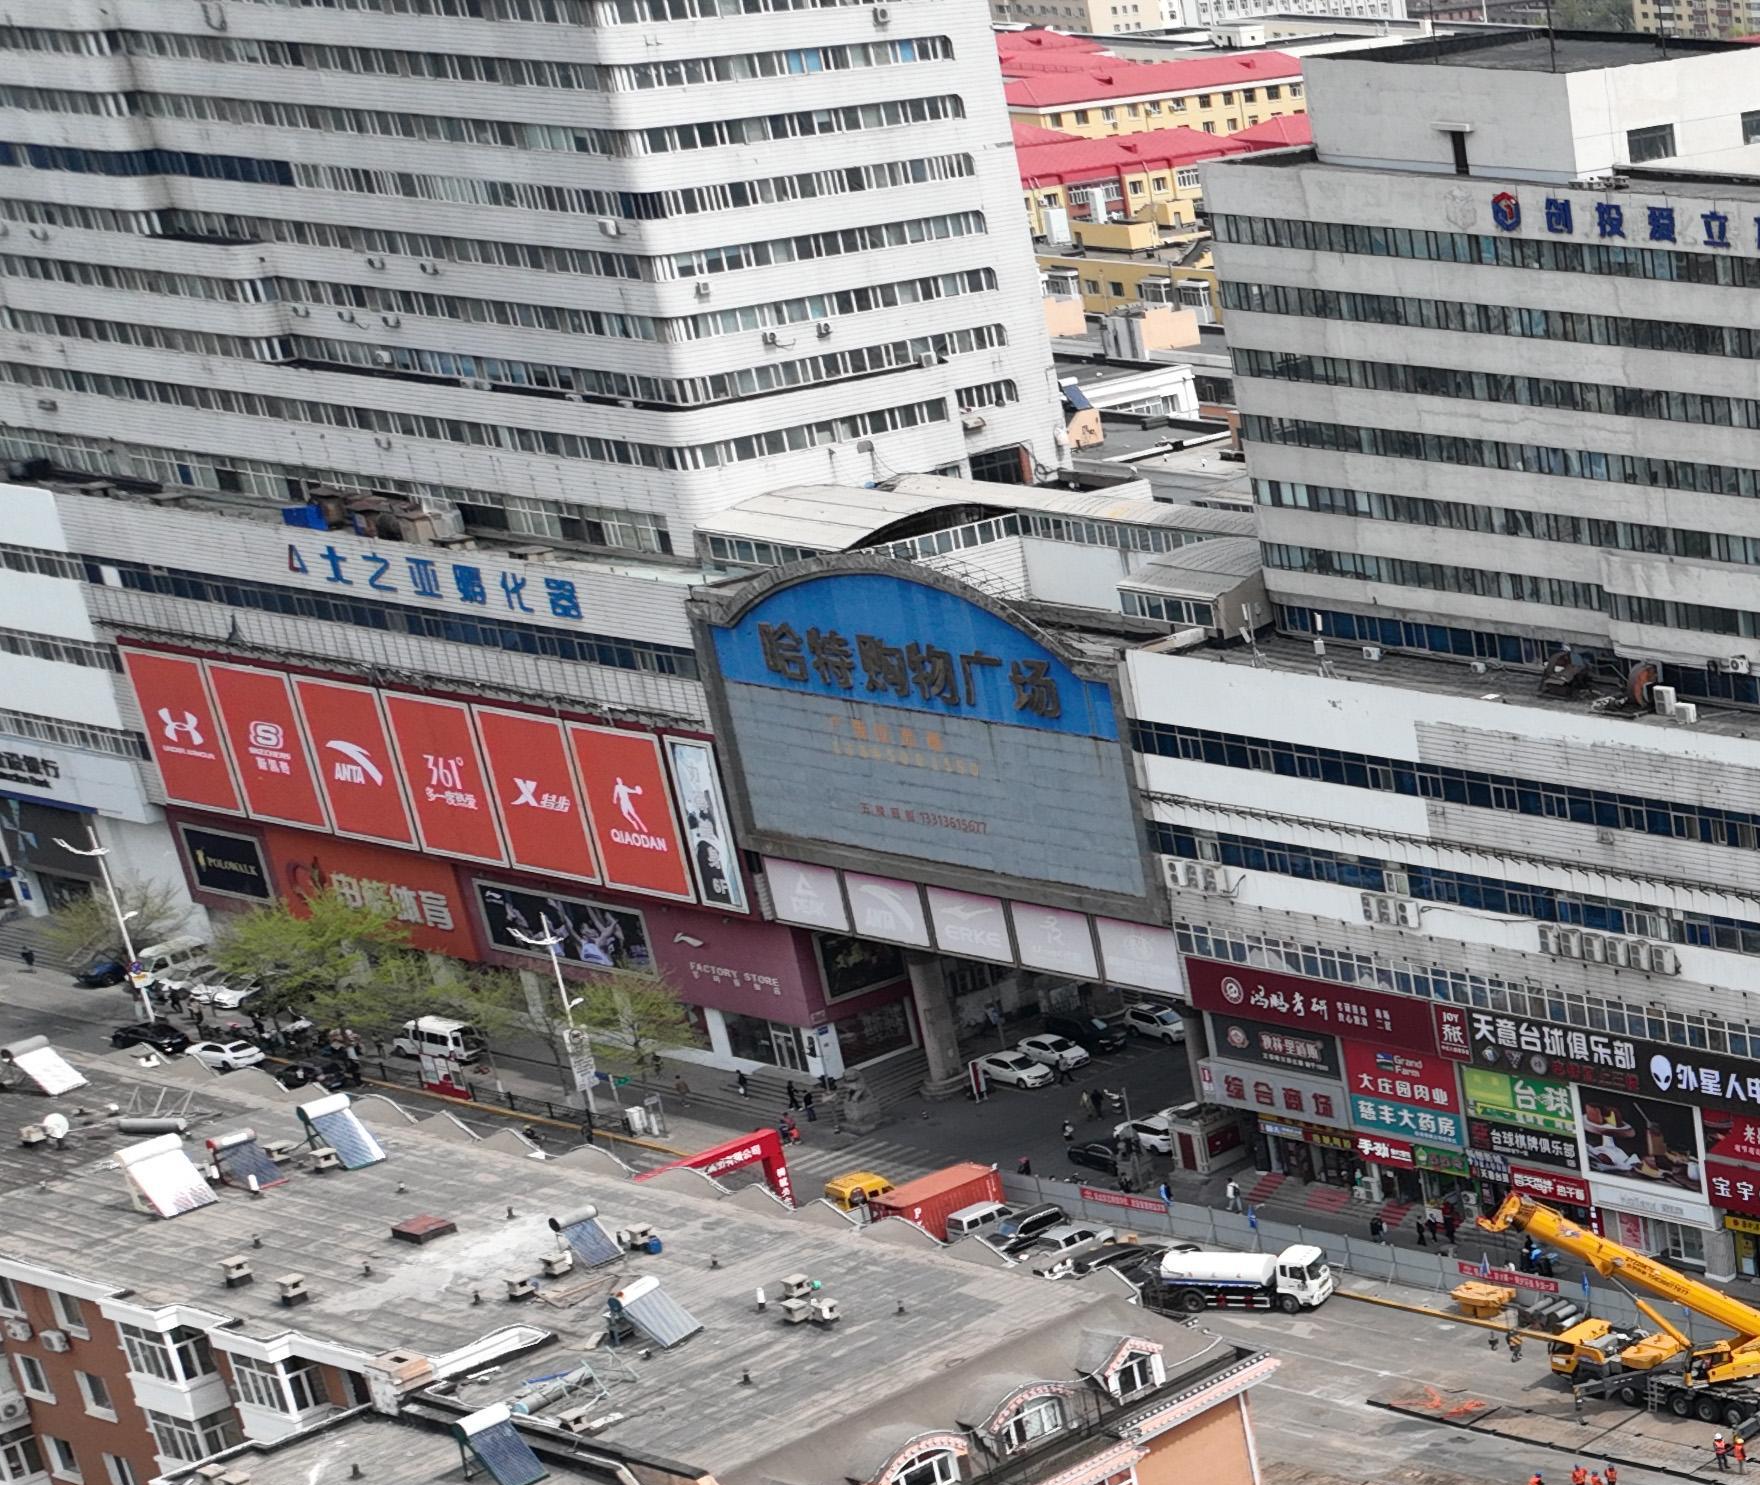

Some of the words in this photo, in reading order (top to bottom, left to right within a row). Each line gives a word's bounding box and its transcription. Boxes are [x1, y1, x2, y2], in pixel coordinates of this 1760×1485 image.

[757, 623, 1061, 718] 哈特购物广场
[335, 762, 366, 785] ANTA
[609, 827, 668, 852] QIAODAN
[944, 924, 1001, 949] ERKE
[690, 961, 738, 981] FACTORY
[743, 972, 779, 988] STORE
[1472, 1012, 1637, 1071] 天意台球俱乐部
[1393, 1056, 1423, 1070] Grand
[1393, 1064, 1421, 1078] Farm
[1224, 1074, 1333, 1119] 综合商场
[1358, 1072, 1449, 1106] 大庄园肉业
[1358, 1100, 1456, 1138] 慈丰大药房
